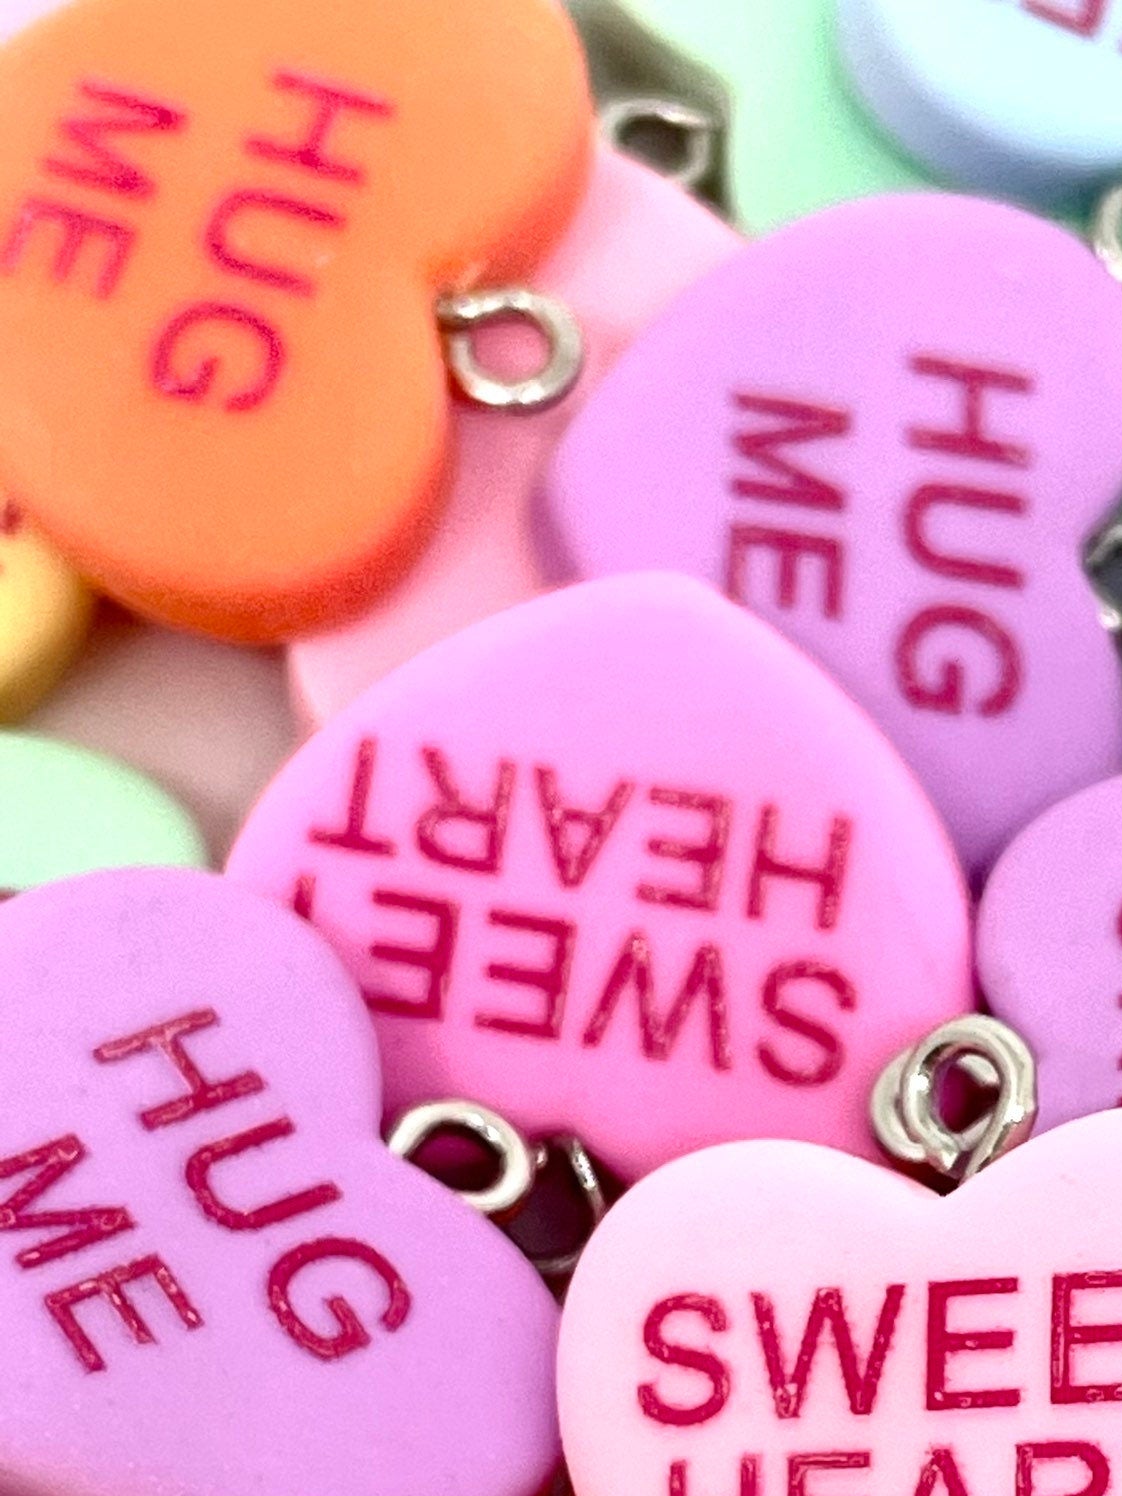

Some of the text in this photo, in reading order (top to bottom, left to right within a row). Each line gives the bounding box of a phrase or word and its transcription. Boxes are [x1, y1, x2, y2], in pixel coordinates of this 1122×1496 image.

[0, 80, 187, 299] ME
[150, 72, 395, 413] HUG
[727, 394, 852, 620] ME
[894, 350, 1036, 719] HUG
[309, 737, 854, 929] HEART
[0, 1134, 204, 1374] ME
[92, 1006, 413, 1362] HUG
